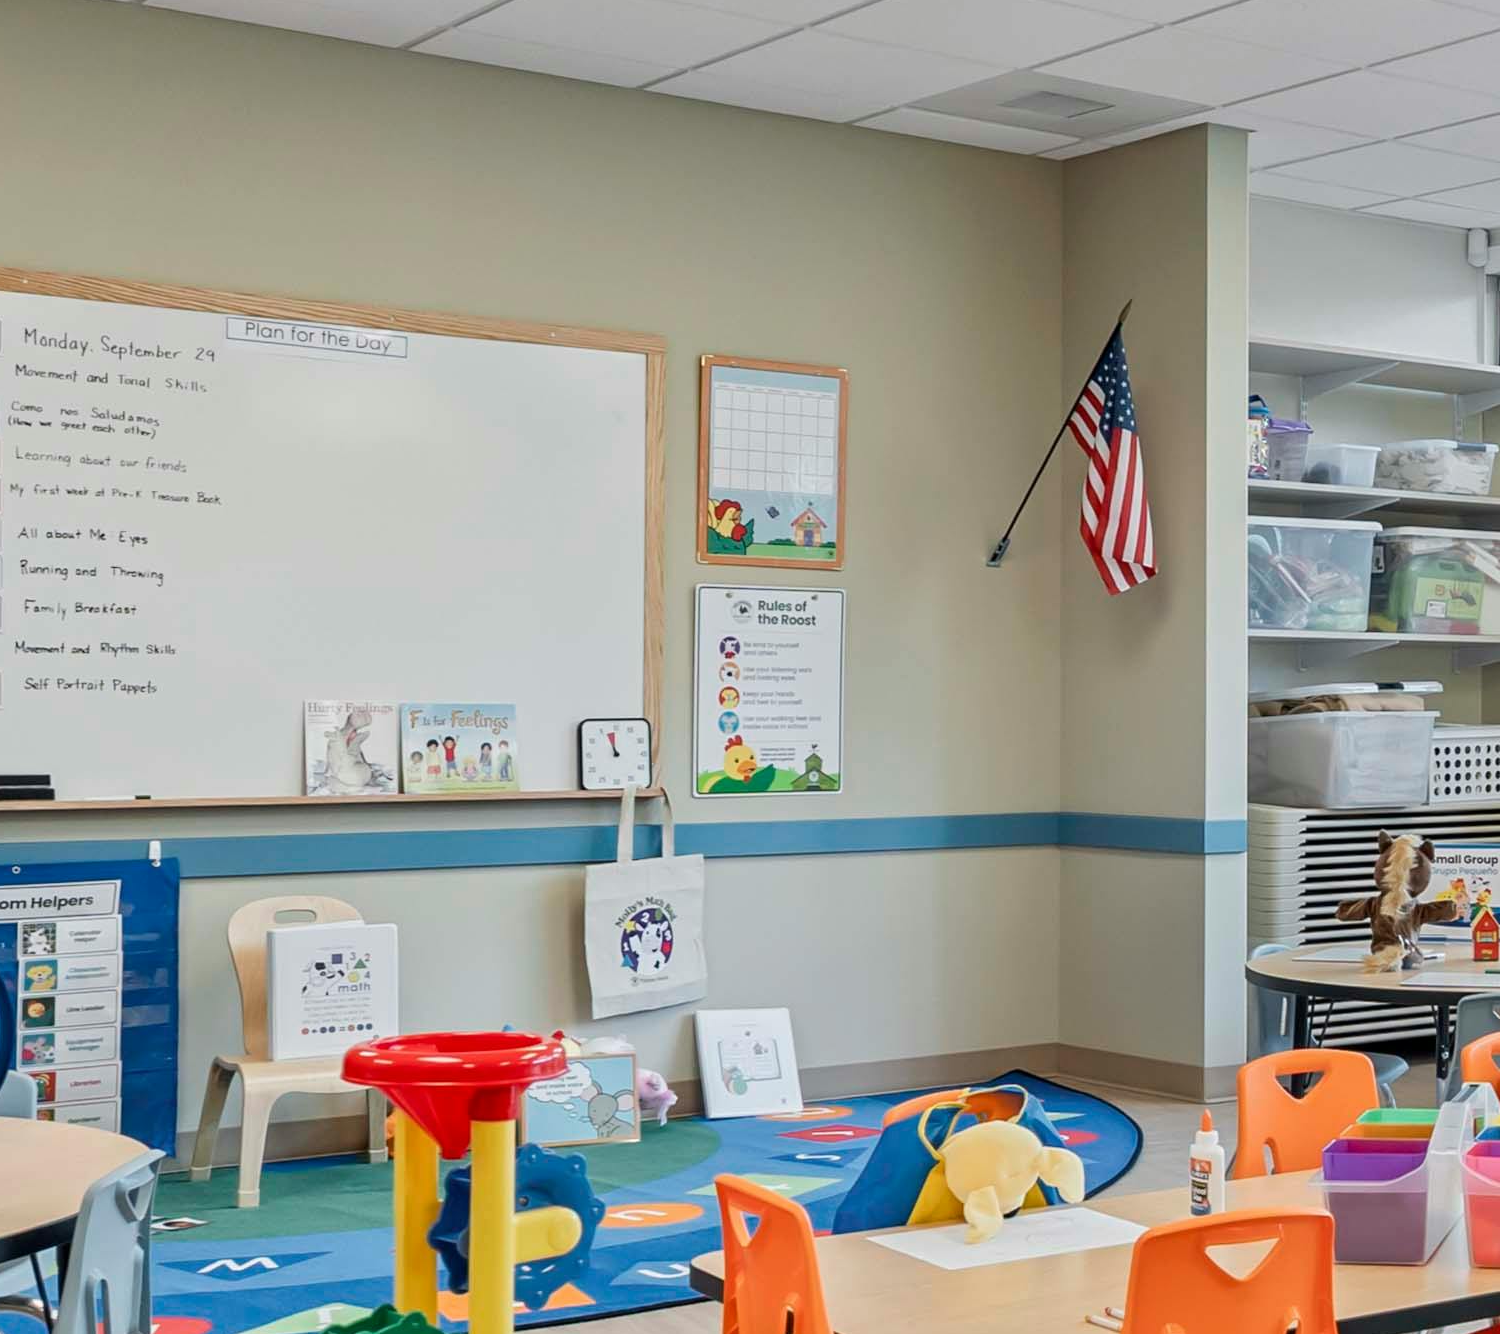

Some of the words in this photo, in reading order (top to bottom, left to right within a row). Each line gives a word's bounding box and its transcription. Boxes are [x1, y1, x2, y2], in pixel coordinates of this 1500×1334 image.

[245, 321, 285, 340] Plan
[291, 326, 315, 343] for
[321, 331, 350, 347] the
[355, 333, 391, 353] Day
[100, 336, 182, 362] September
[194, 346, 216, 363] 29
[15, 364, 78, 383] Movement
[87, 371, 109, 385] and
[117, 374, 151, 389] Tonal
[165, 378, 207, 393] Skills
[11, 401, 44, 413] Como
[91, 407, 160, 427] Saludamos
[60, 420, 87, 432] greet
[92, 422, 116, 433] each
[124, 425, 156, 440] other)
[15, 446, 72, 466] Learning
[79, 455, 111, 466] about
[120, 458, 139, 467] our
[145, 456, 187, 473] friends
[10, 483, 24, 497] My
[33, 483, 59, 496] first
[66, 485, 89, 496] week
[196, 492, 222, 506] Book
[18, 528, 38, 539] All
[45, 528, 81, 540] about
[89, 528, 106, 541] Me
[118, 531, 148, 548] Eyes
[20, 559, 68, 580] Running
[75, 566, 97, 577] and
[111, 565, 164, 587] Throwing
[24, 599, 67, 619] Family
[74, 601, 137, 615] Breakfast
[758, 600, 792, 612] Rules
[794, 601, 807, 612] of
[758, 614, 779, 624] the
[781, 614, 817, 626] Roost
[14, 640, 65, 655] Movement
[71, 642, 90, 654] and
[100, 642, 139, 657] Rhythm
[146, 643, 176, 655] Skills
[24, 677, 51, 691] Self
[56, 677, 105, 692] Portrait
[345, 702, 393, 717] Feelings
[409, 709, 423, 729] F
[450, 709, 509, 735] Feelings
[1464, 854, 1499, 868] Group
[30, 895, 94, 911] Helpers
[615, 900, 644, 929] Molly's
[641, 912, 650, 922] 2
[664, 930, 672, 941] 3
[623, 942, 629, 951] 1
[338, 983, 371, 992] math
